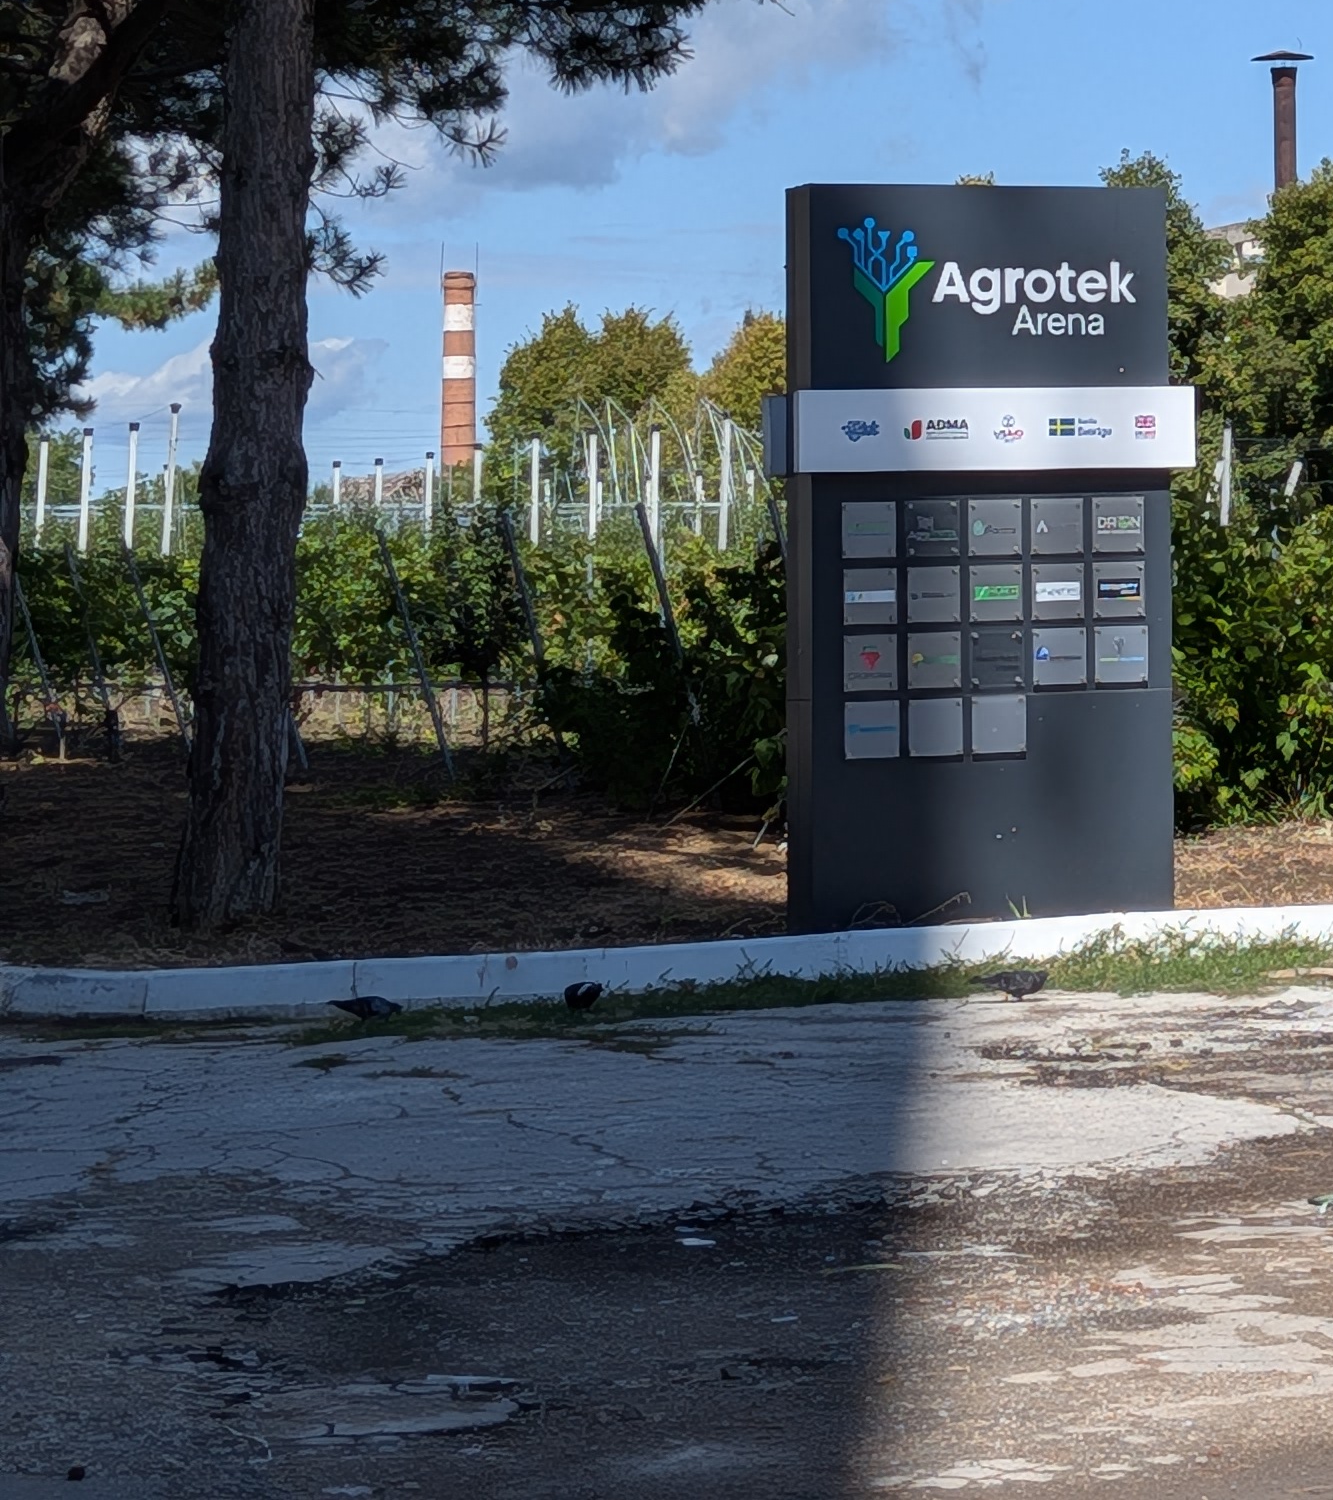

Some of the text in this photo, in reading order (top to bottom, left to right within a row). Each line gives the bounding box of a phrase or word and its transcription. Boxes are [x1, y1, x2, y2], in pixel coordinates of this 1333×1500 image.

[932, 260, 1136, 315] Agrotek
[1012, 304, 1105, 336] Arena
[926, 419, 968, 430] ADMA
